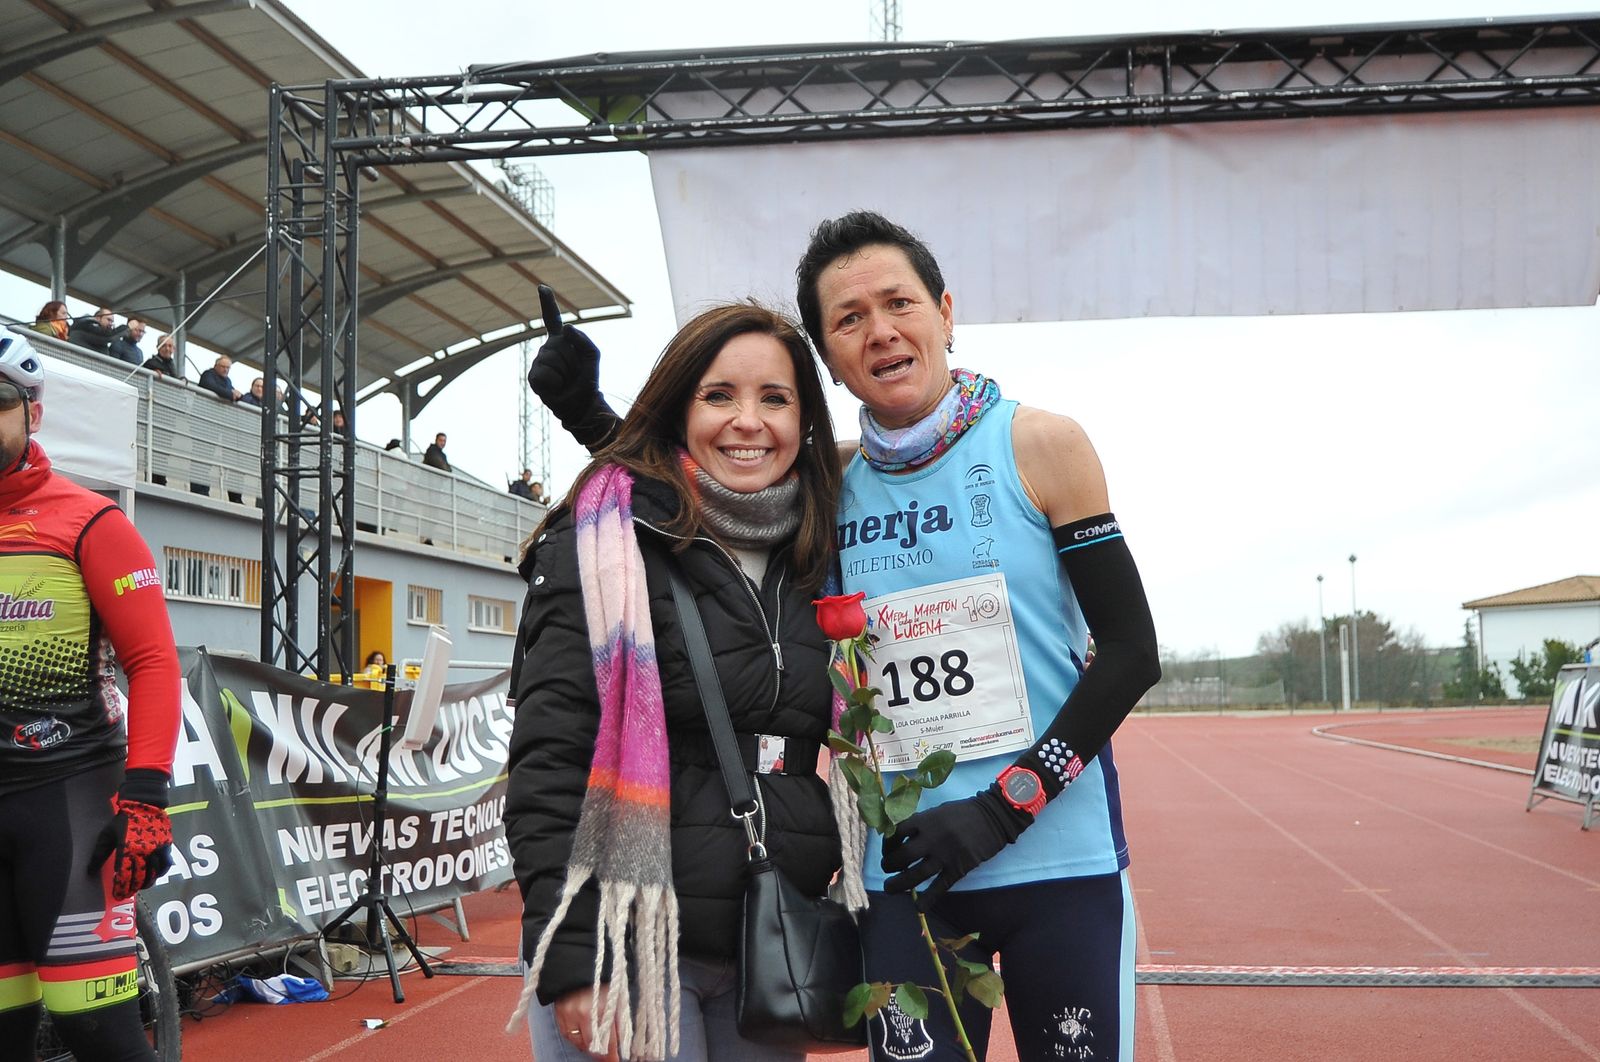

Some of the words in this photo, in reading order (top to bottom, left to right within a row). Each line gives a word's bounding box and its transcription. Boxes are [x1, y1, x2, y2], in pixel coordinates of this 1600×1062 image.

[838, 501, 954, 551] nerja
[846, 549, 933, 578] ATLETISMO
[914, 599, 957, 618] MARATÓN
[893, 618, 949, 640] LUCENA
[882, 649, 974, 708] 188
[909, 715, 940, 726] CHICLANA
[940, 710, 971, 721] PARRILLA
[277, 813, 420, 866] NUEVAS
[157, 893, 223, 945] OS
